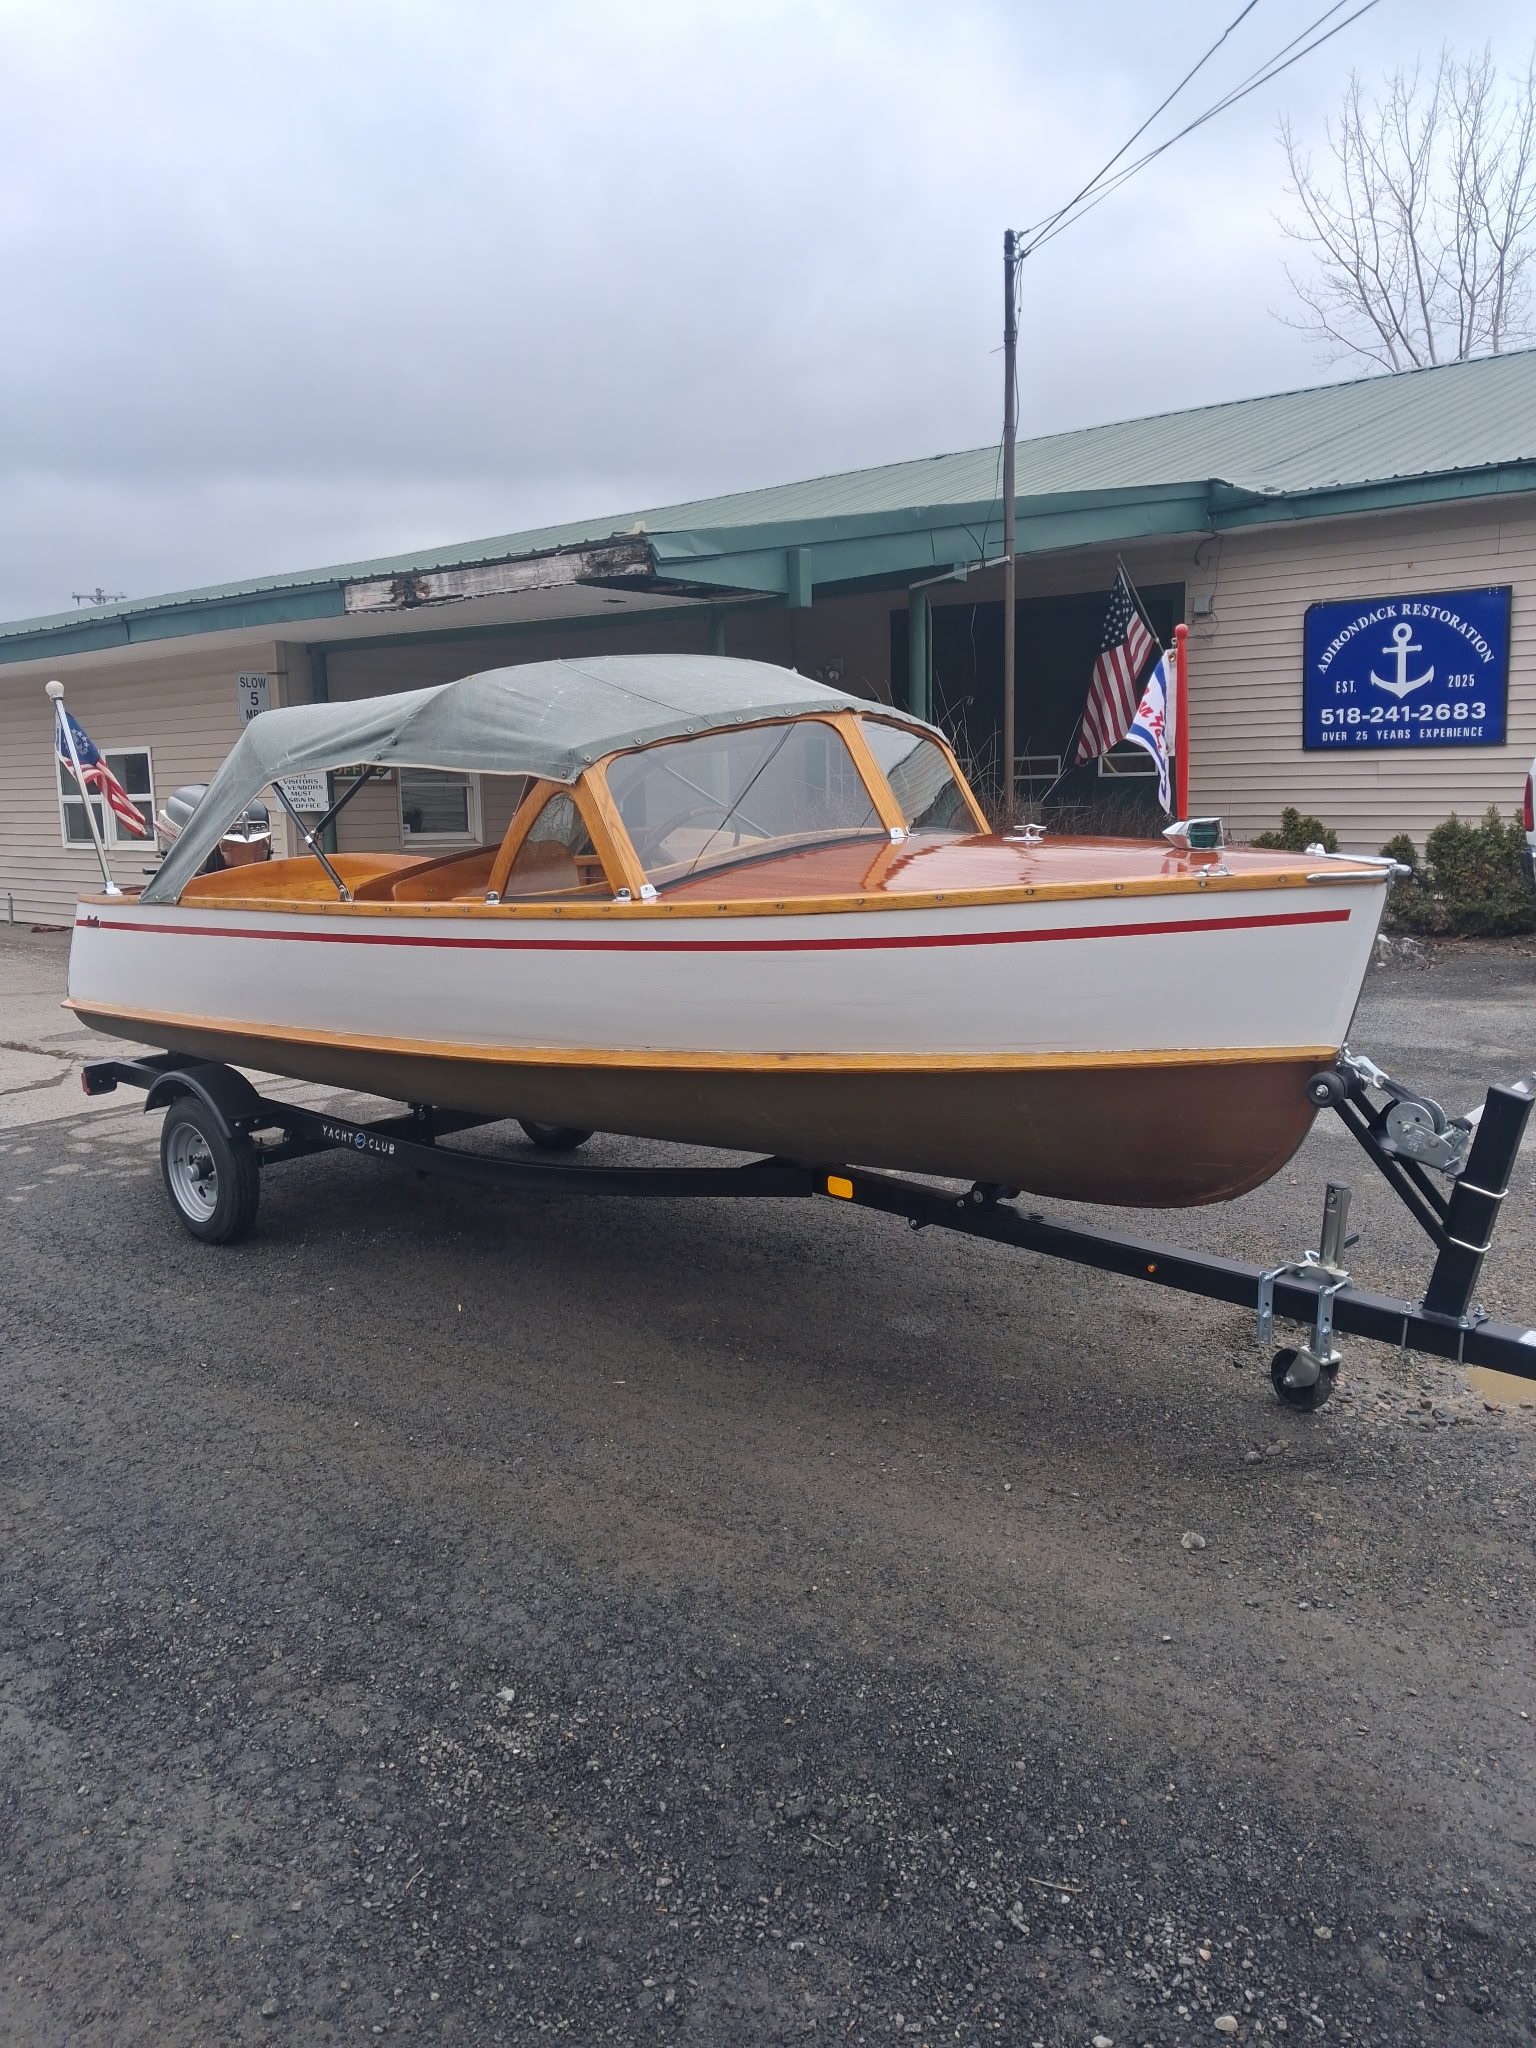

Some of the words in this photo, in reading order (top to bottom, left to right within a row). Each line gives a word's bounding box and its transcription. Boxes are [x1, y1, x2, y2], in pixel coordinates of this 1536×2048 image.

[1317, 605, 1398, 674] ADIRONDACK
[1402, 603, 1495, 664] RESTORATION
[240, 676, 267, 689] SLOW
[1335, 680, 1358, 694] EST.
[1448, 674, 1475, 688] 2025
[250, 691, 260, 706] 5
[1320, 701, 1487, 726] 518-241-2683
[1322, 731, 1348, 742] OVER
[1356, 730, 1369, 741] 25
[1376, 728, 1411, 740] YEARS
[1419, 726, 1484, 739] EXPERIENCE
[322, 1124, 354, 1143] YACHT
[368, 1138, 396, 1155] CLUB
